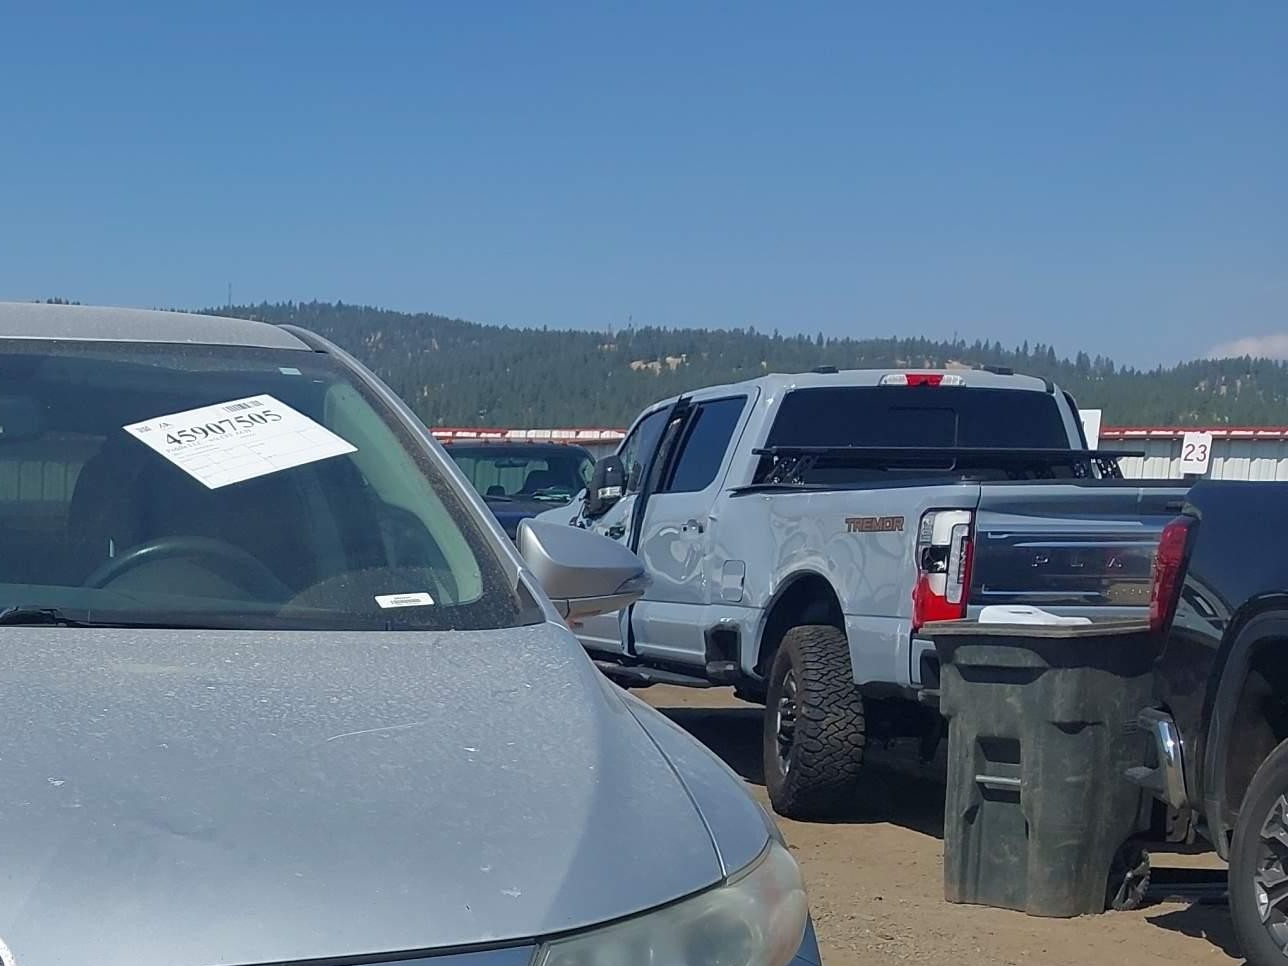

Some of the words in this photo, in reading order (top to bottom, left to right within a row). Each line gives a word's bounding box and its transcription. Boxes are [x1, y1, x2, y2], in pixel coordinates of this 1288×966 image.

[166, 410, 282, 446] 45907505
[1183, 443, 1208, 462] 23
[845, 516, 905, 532] TREMOR
